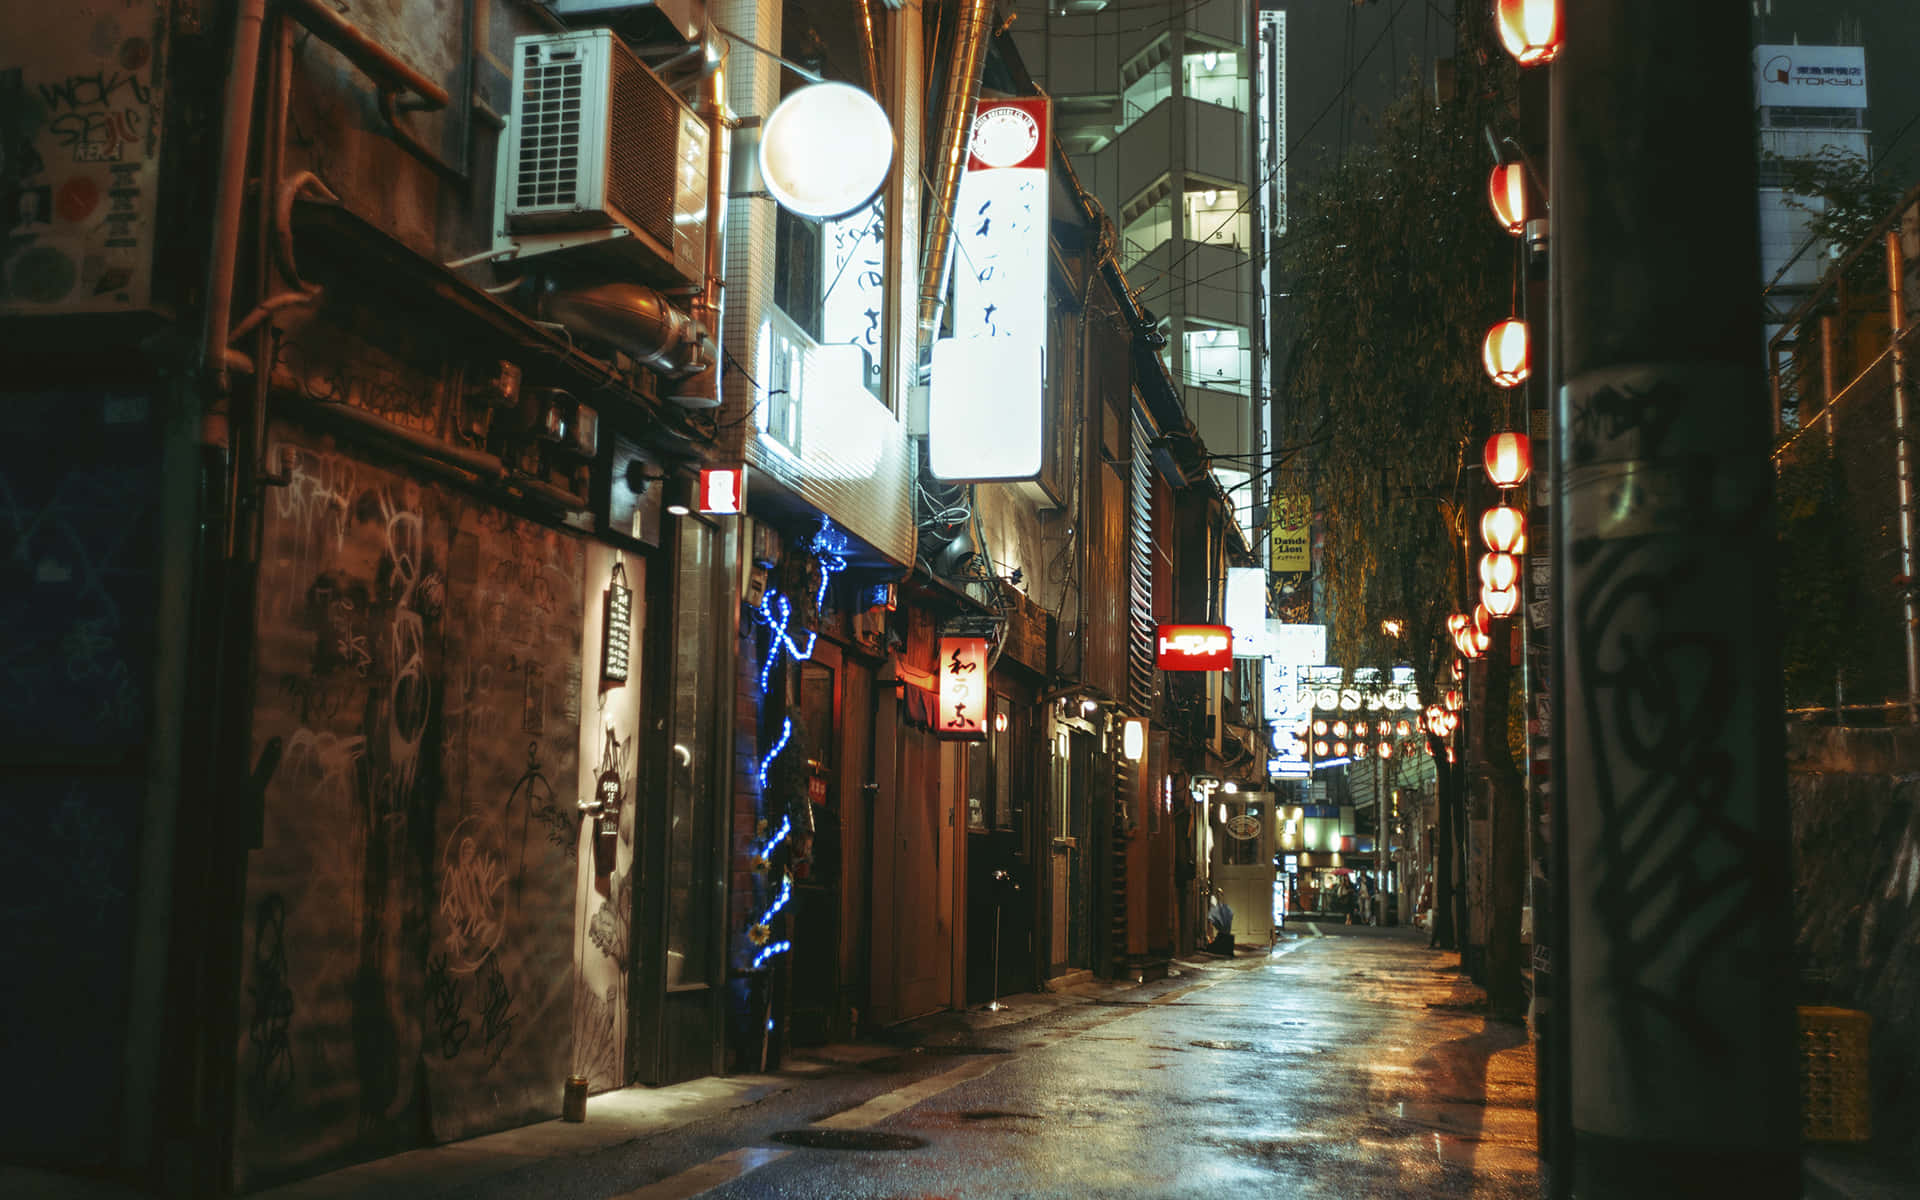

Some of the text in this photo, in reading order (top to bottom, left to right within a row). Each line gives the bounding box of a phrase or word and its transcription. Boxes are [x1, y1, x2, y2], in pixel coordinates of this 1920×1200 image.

[1791, 77, 1864, 86] TOKYU
[1279, 545, 1303, 553] Lion
[603, 781, 618, 793] OPEN
